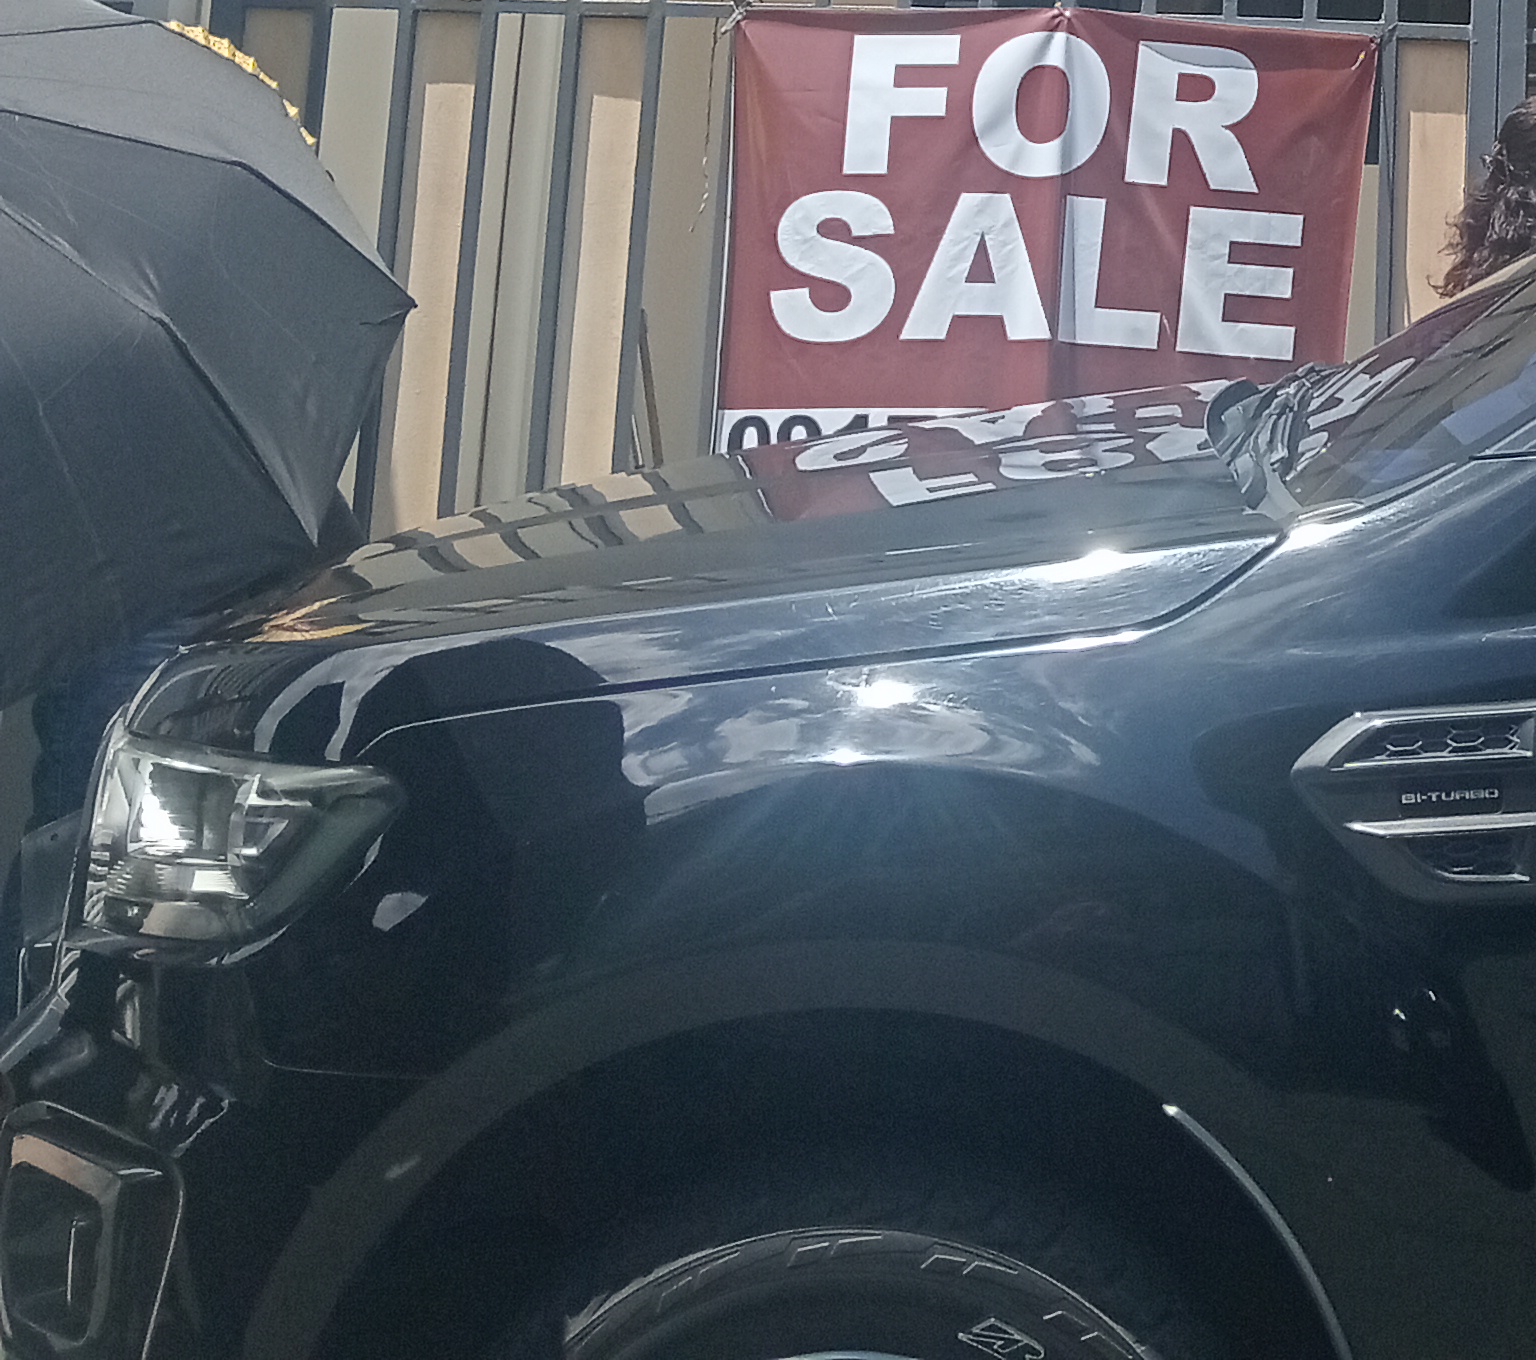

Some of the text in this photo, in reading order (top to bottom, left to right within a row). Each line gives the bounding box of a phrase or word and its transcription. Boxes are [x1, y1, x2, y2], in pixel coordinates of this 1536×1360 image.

[842, 30, 1259, 194] FOR
[768, 189, 1304, 361] SALE
[1401, 788, 1500, 805] BI-TURBO
